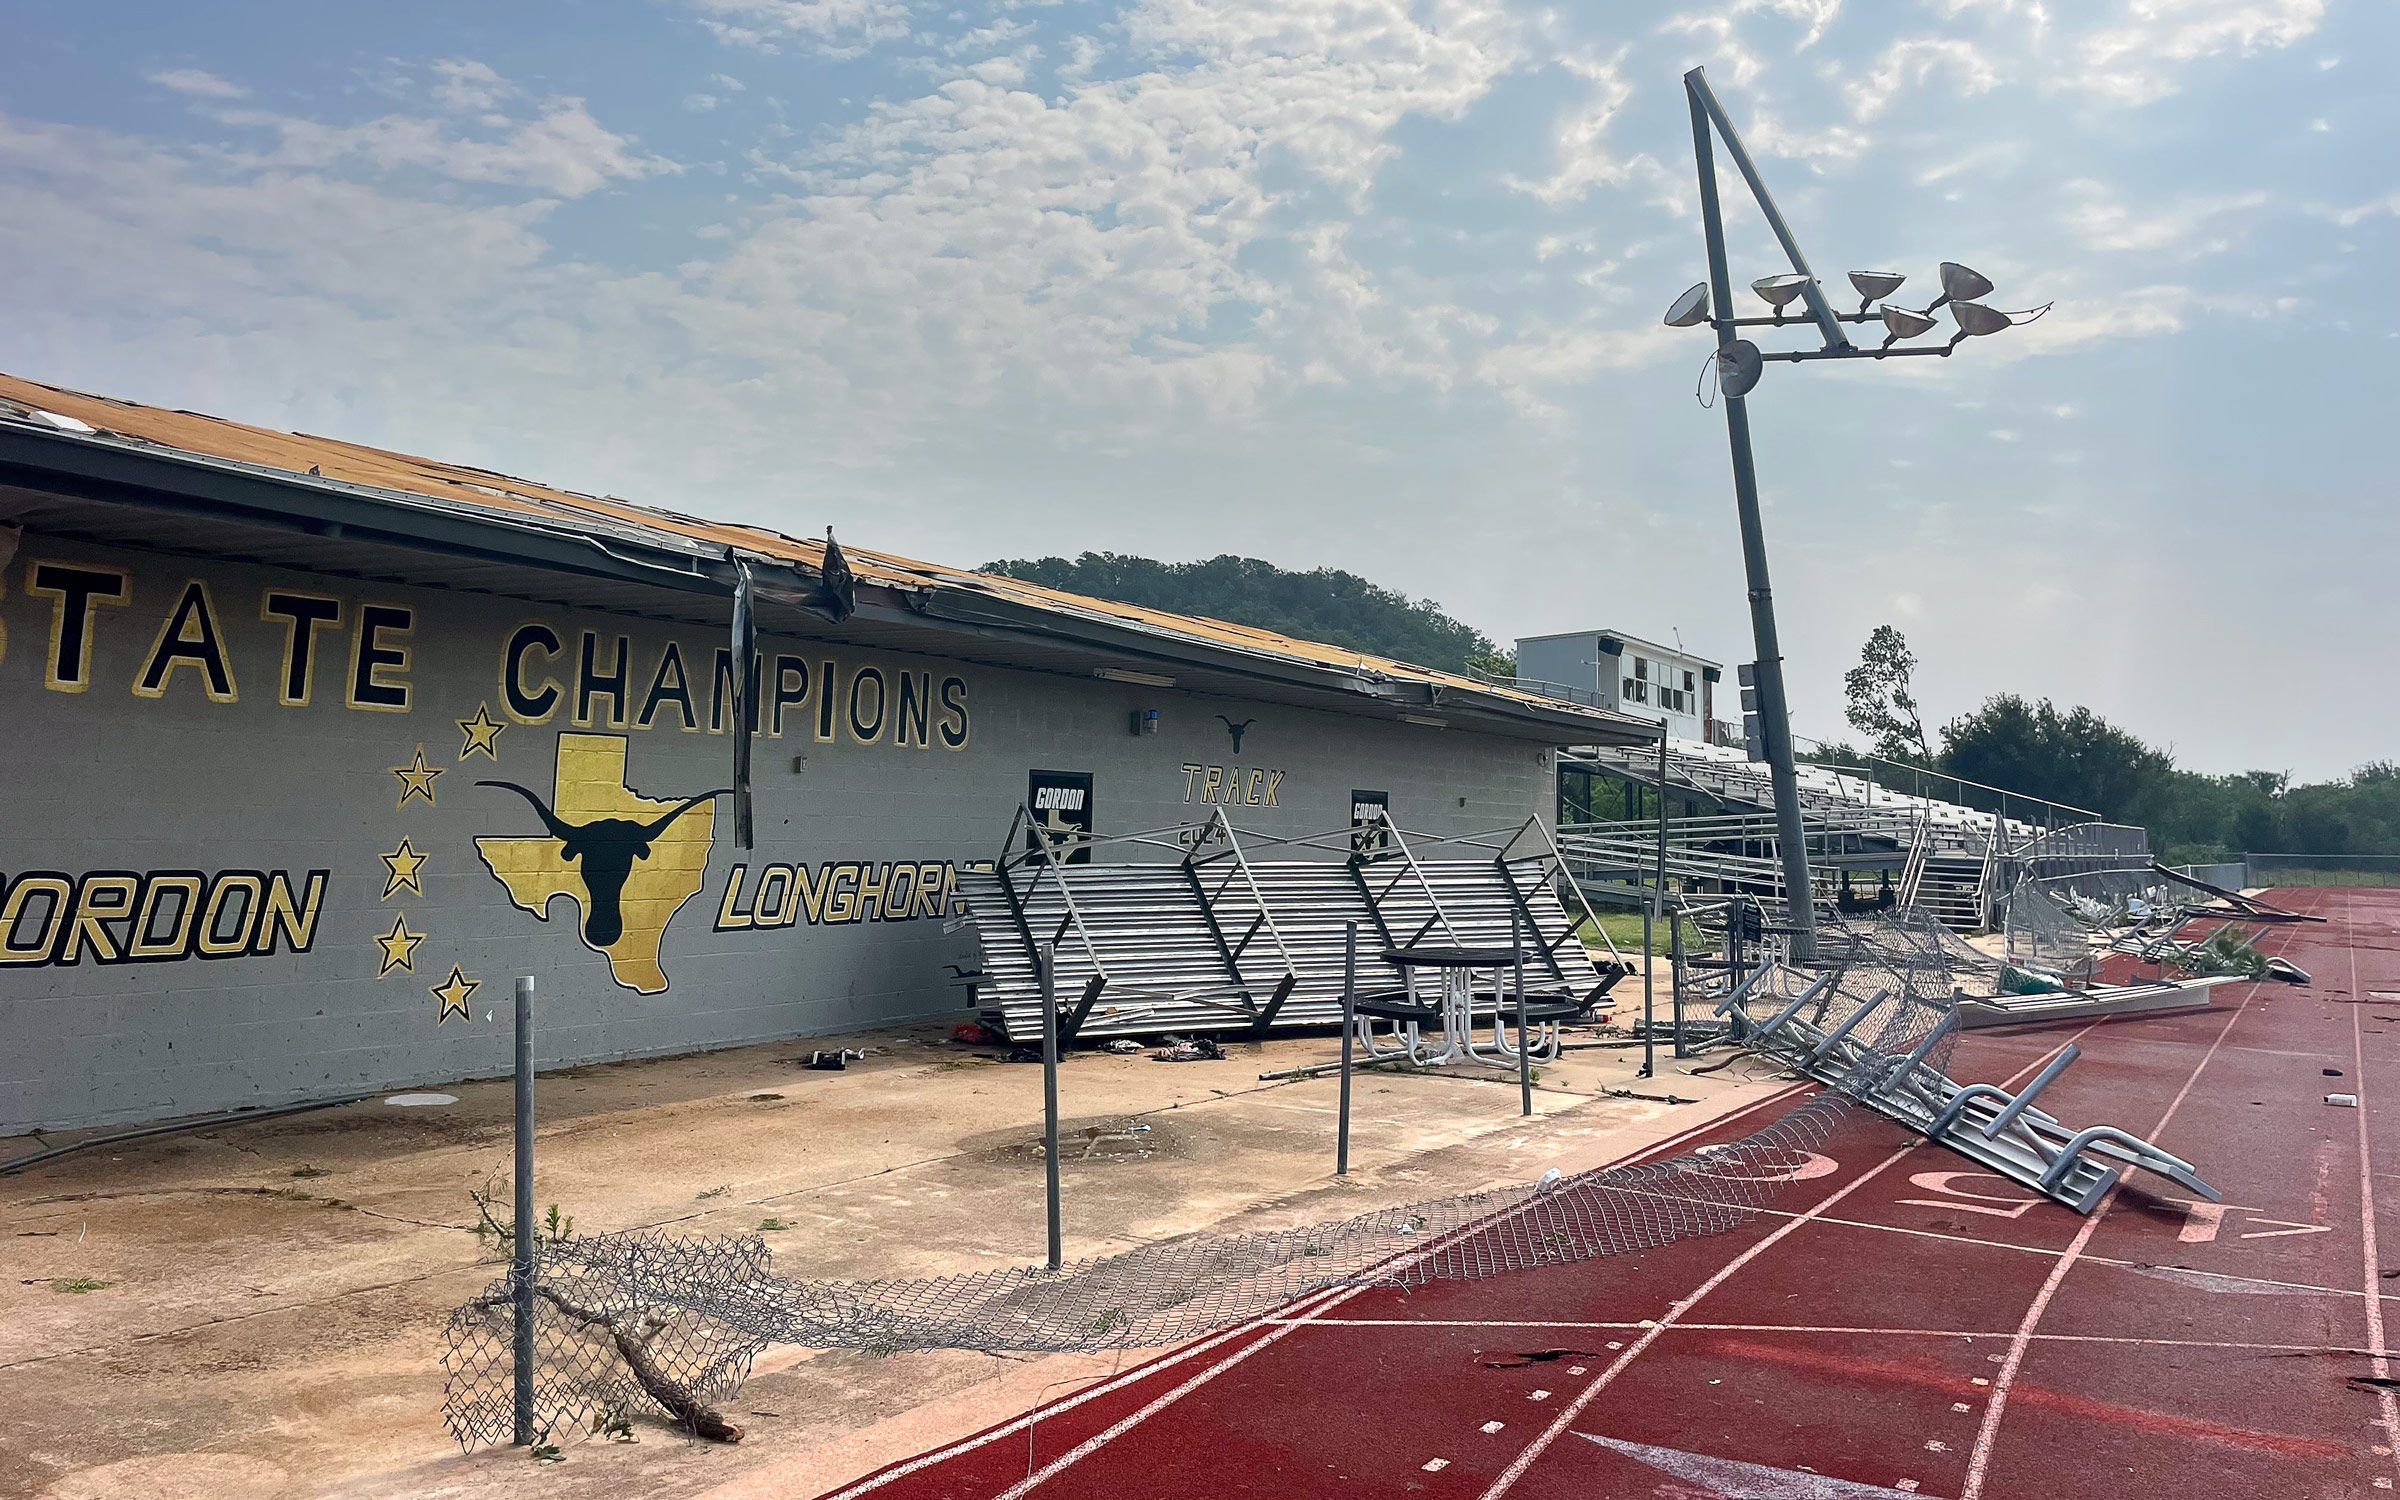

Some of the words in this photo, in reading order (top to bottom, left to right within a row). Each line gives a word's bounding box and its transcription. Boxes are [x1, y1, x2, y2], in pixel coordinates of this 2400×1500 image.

[0, 560, 416, 713] TATE
[500, 620, 972, 752] CHAMPIONS
[1035, 787, 1084, 810] GORDON
[1181, 762, 1286, 808] TRACK
[0, 869, 330, 968] ORDON
[713, 860, 997, 933] LONGHORN
